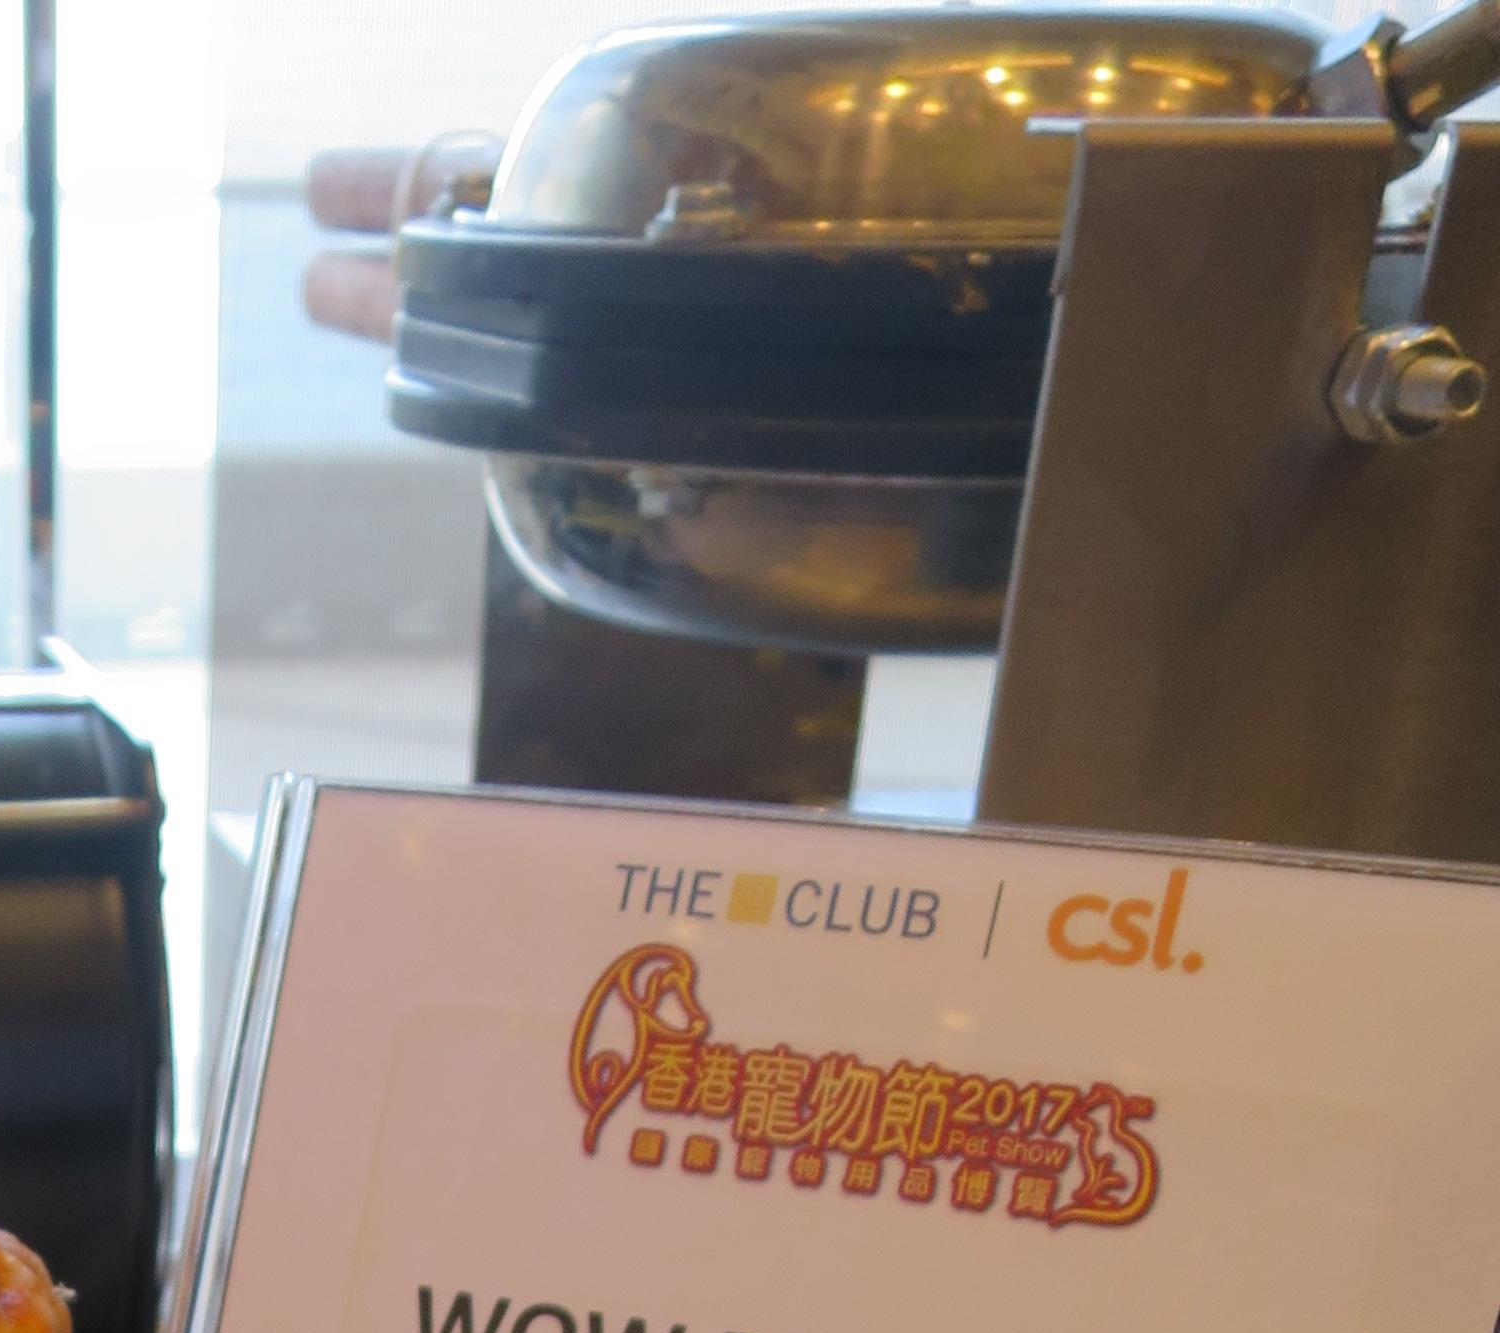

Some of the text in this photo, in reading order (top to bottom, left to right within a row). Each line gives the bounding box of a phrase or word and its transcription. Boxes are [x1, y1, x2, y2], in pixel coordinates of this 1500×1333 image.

[614, 863, 722, 920] THE
[783, 878, 941, 940] CLUB
[953, 1079, 1075, 1134] 2017
[947, 1129, 1067, 1168] Pet Show
